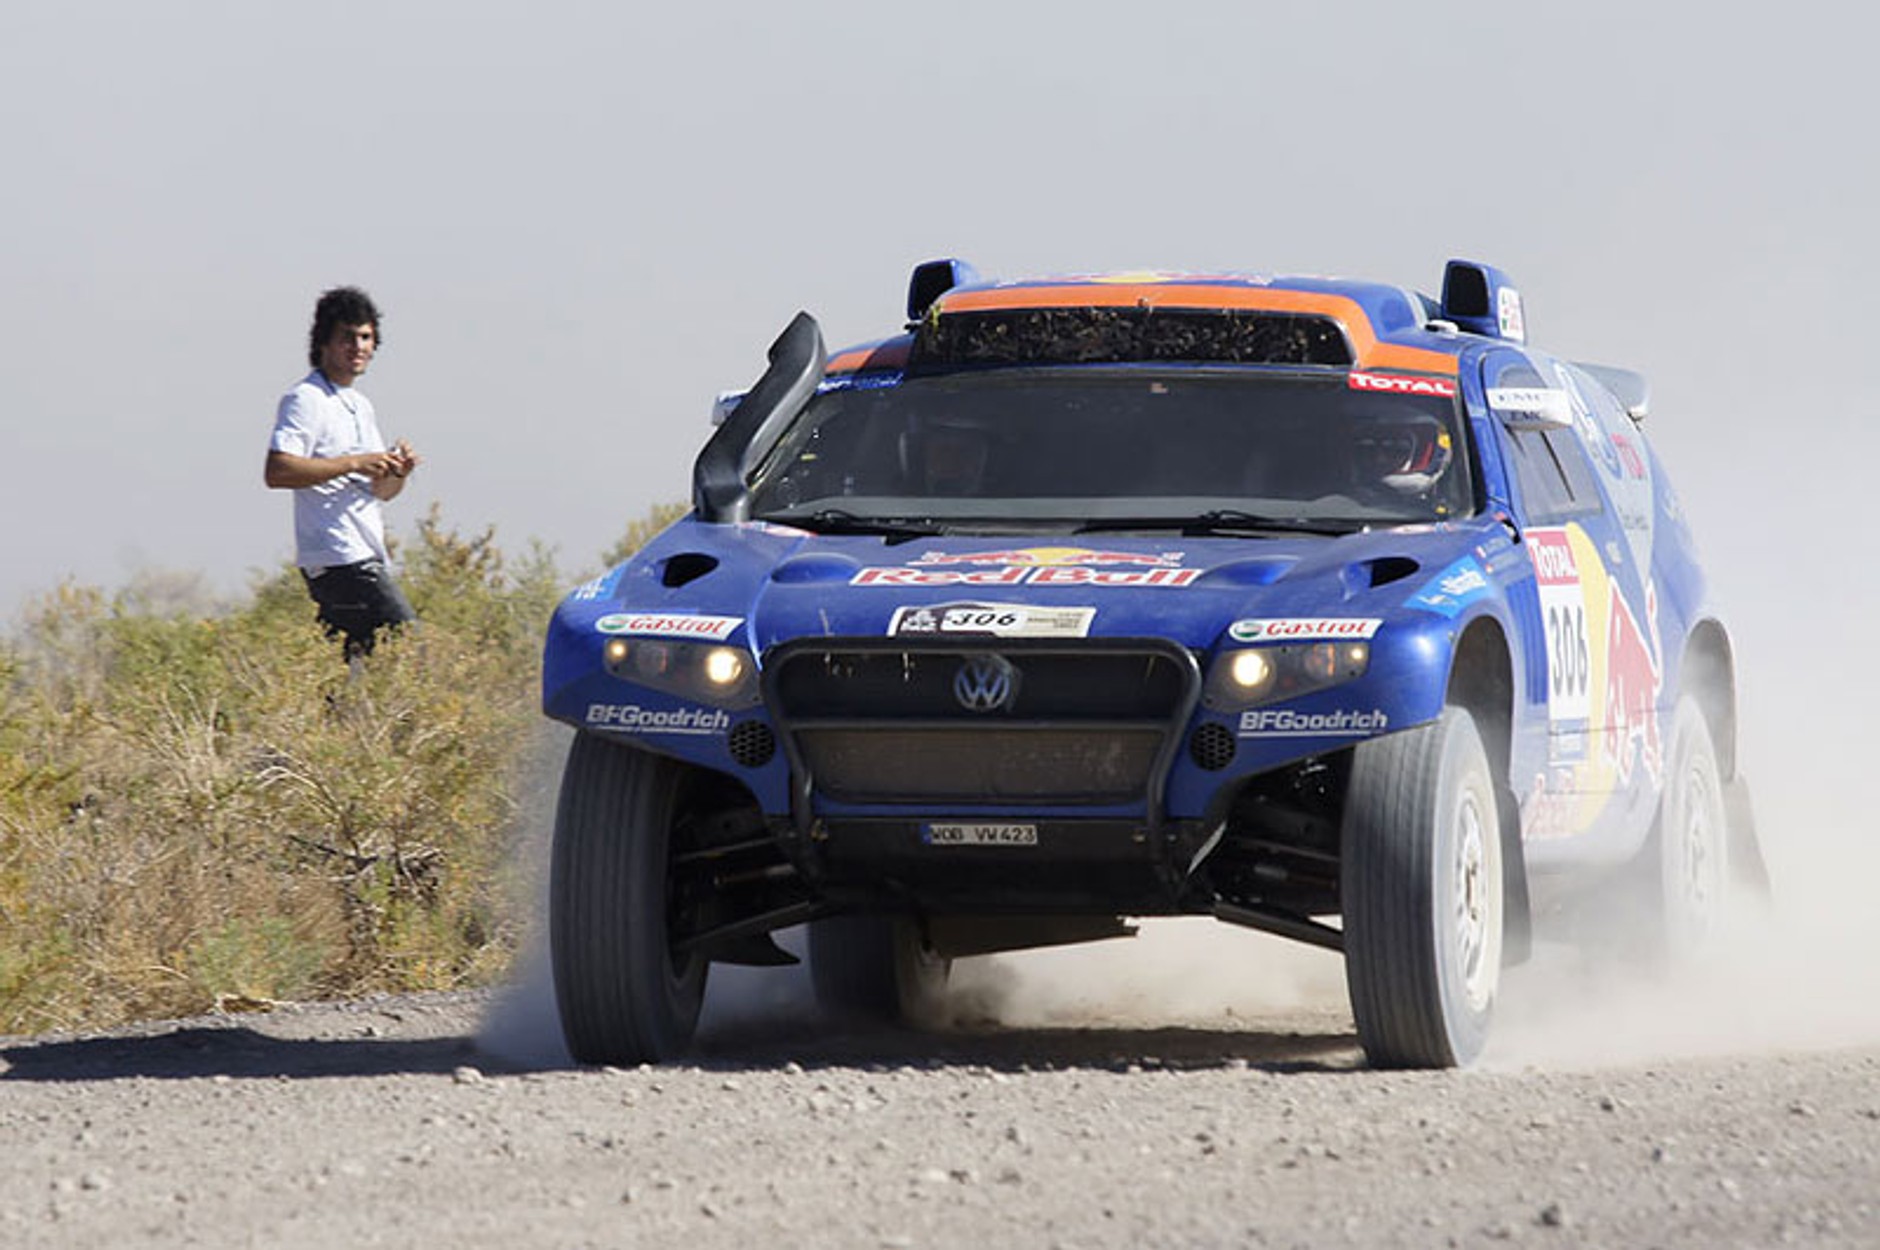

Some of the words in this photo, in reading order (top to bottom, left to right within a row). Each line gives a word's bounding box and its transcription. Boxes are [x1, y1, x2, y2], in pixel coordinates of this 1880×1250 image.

[1349, 373, 1455, 394] TOTAL
[1527, 537, 1580, 579] TOTAL
[851, 567, 1025, 585] Red
[1026, 567, 1202, 586] Bull
[629, 617, 728, 634] Castrol
[952, 613, 1016, 626] 306
[1266, 619, 1368, 636] Castrol
[1551, 605, 1588, 697] 306
[586, 704, 730, 729] BFGoodrich
[1239, 710, 1388, 731] BFGoodrich
